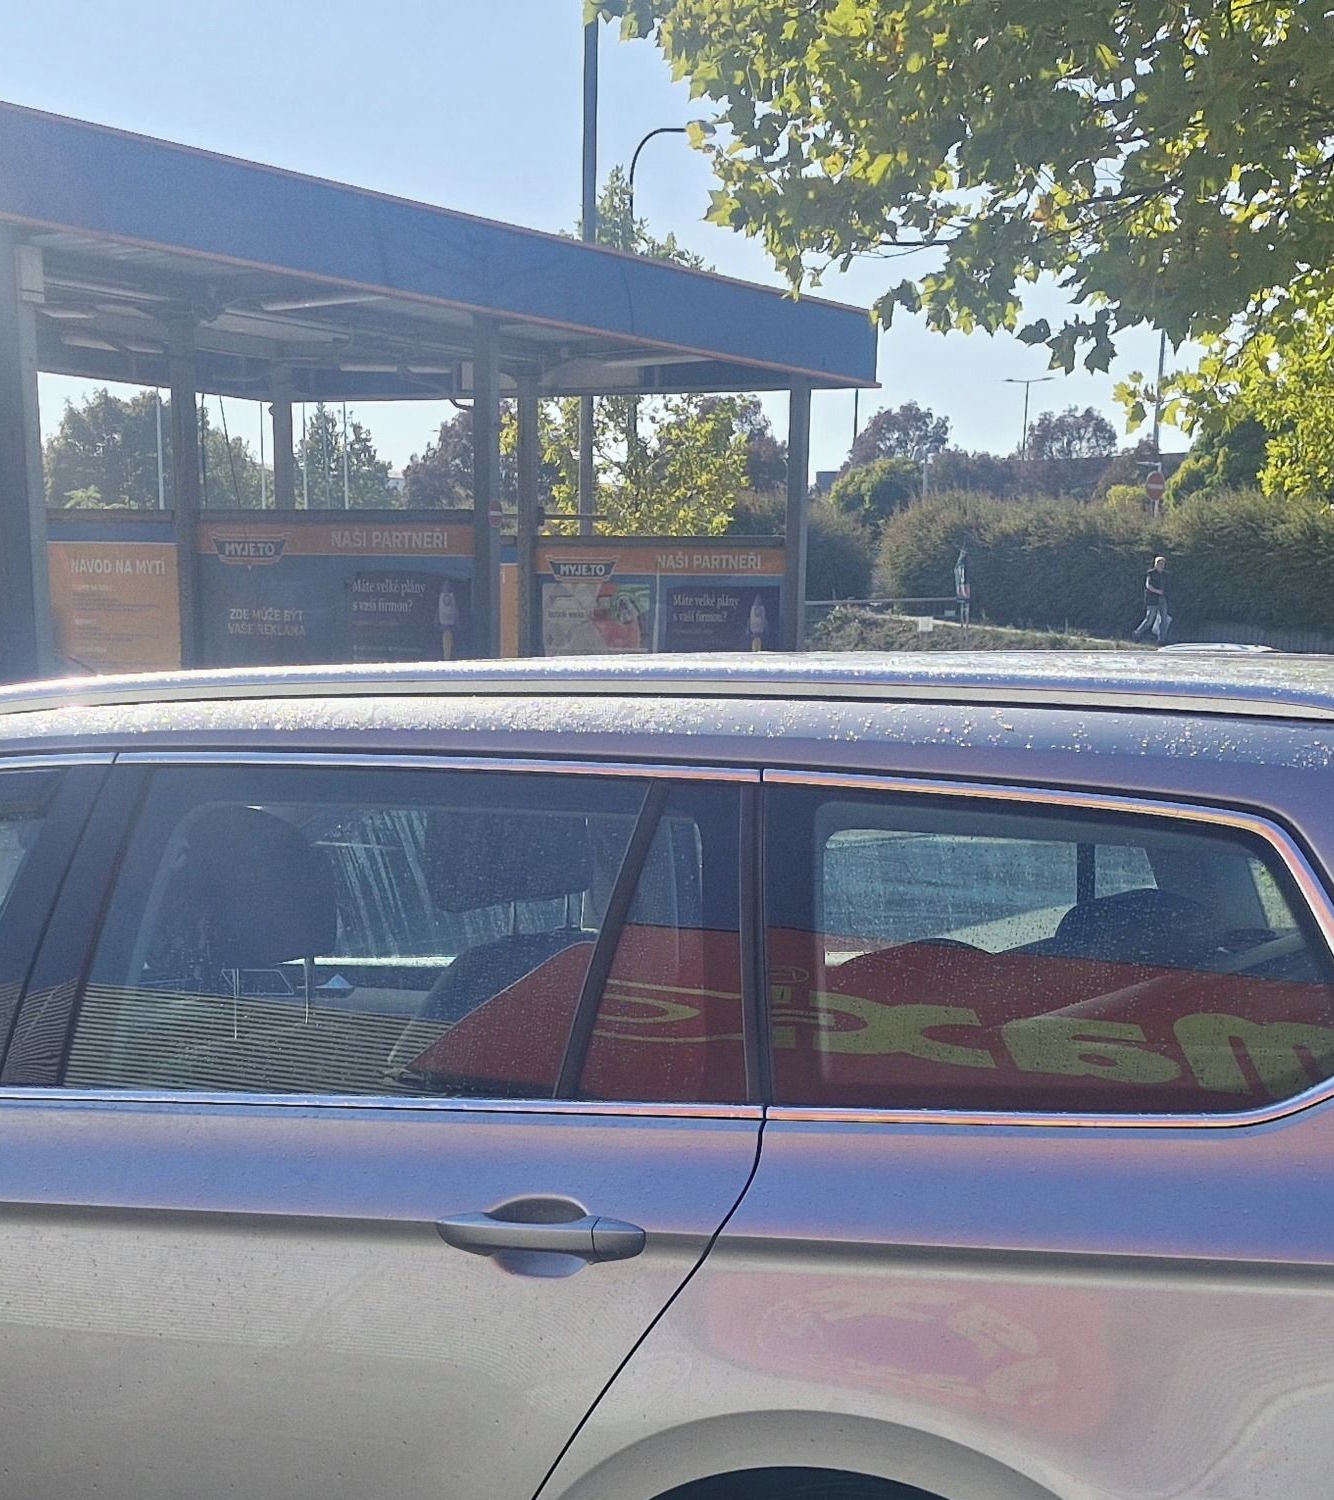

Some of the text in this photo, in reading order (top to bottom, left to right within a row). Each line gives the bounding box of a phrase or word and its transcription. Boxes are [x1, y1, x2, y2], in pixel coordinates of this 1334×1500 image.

[331, 529, 448, 549] NAŠI PARTNEŘI
[224, 542, 276, 557] MYJE.TO
[116, 559, 133, 574] NA
[657, 551, 761, 570] NAŠI PARTNEŘI
[559, 564, 606, 577] MYJE.TO
[673, 594, 694, 607] Máte
[229, 608, 250, 621] ZDE
